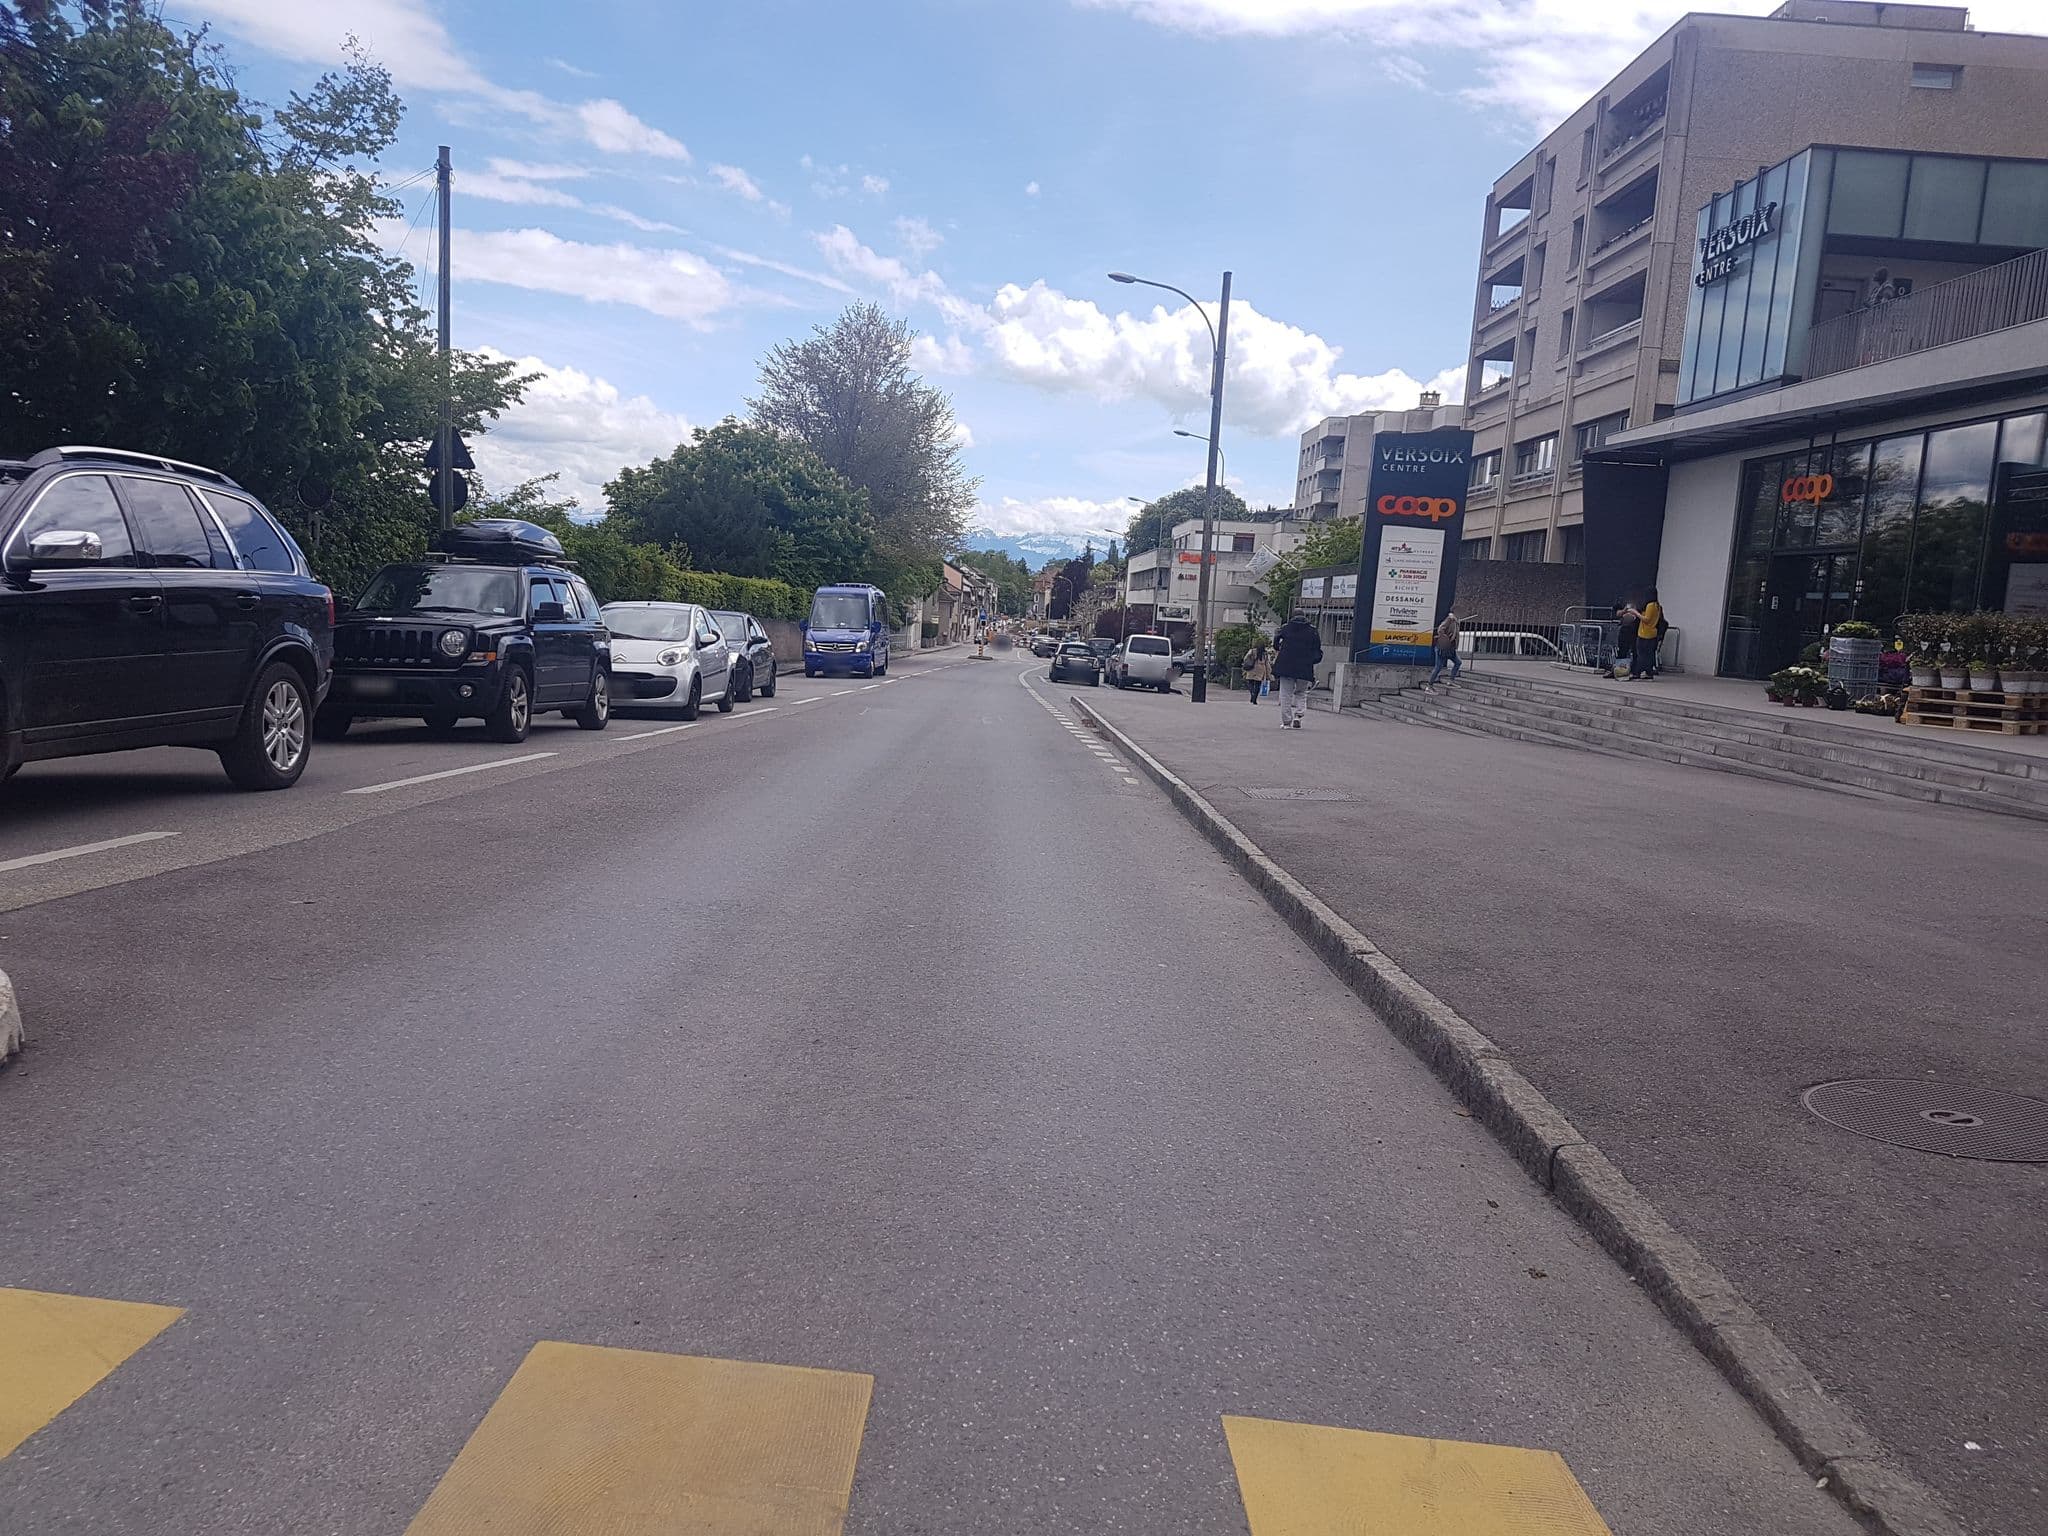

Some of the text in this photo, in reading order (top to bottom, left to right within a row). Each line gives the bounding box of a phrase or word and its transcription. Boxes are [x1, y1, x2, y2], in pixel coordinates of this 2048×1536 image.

[1699, 202, 1777, 262] VERSOIX
[1694, 257, 1734, 289] CENTRE
[1382, 447, 1464, 464] VERSOIX
[1383, 464, 1426, 472] CENTRE
[1782, 474, 1833, 505] coop
[1377, 495, 1457, 522] coop
[1386, 595, 1425, 603] DESSANGE
